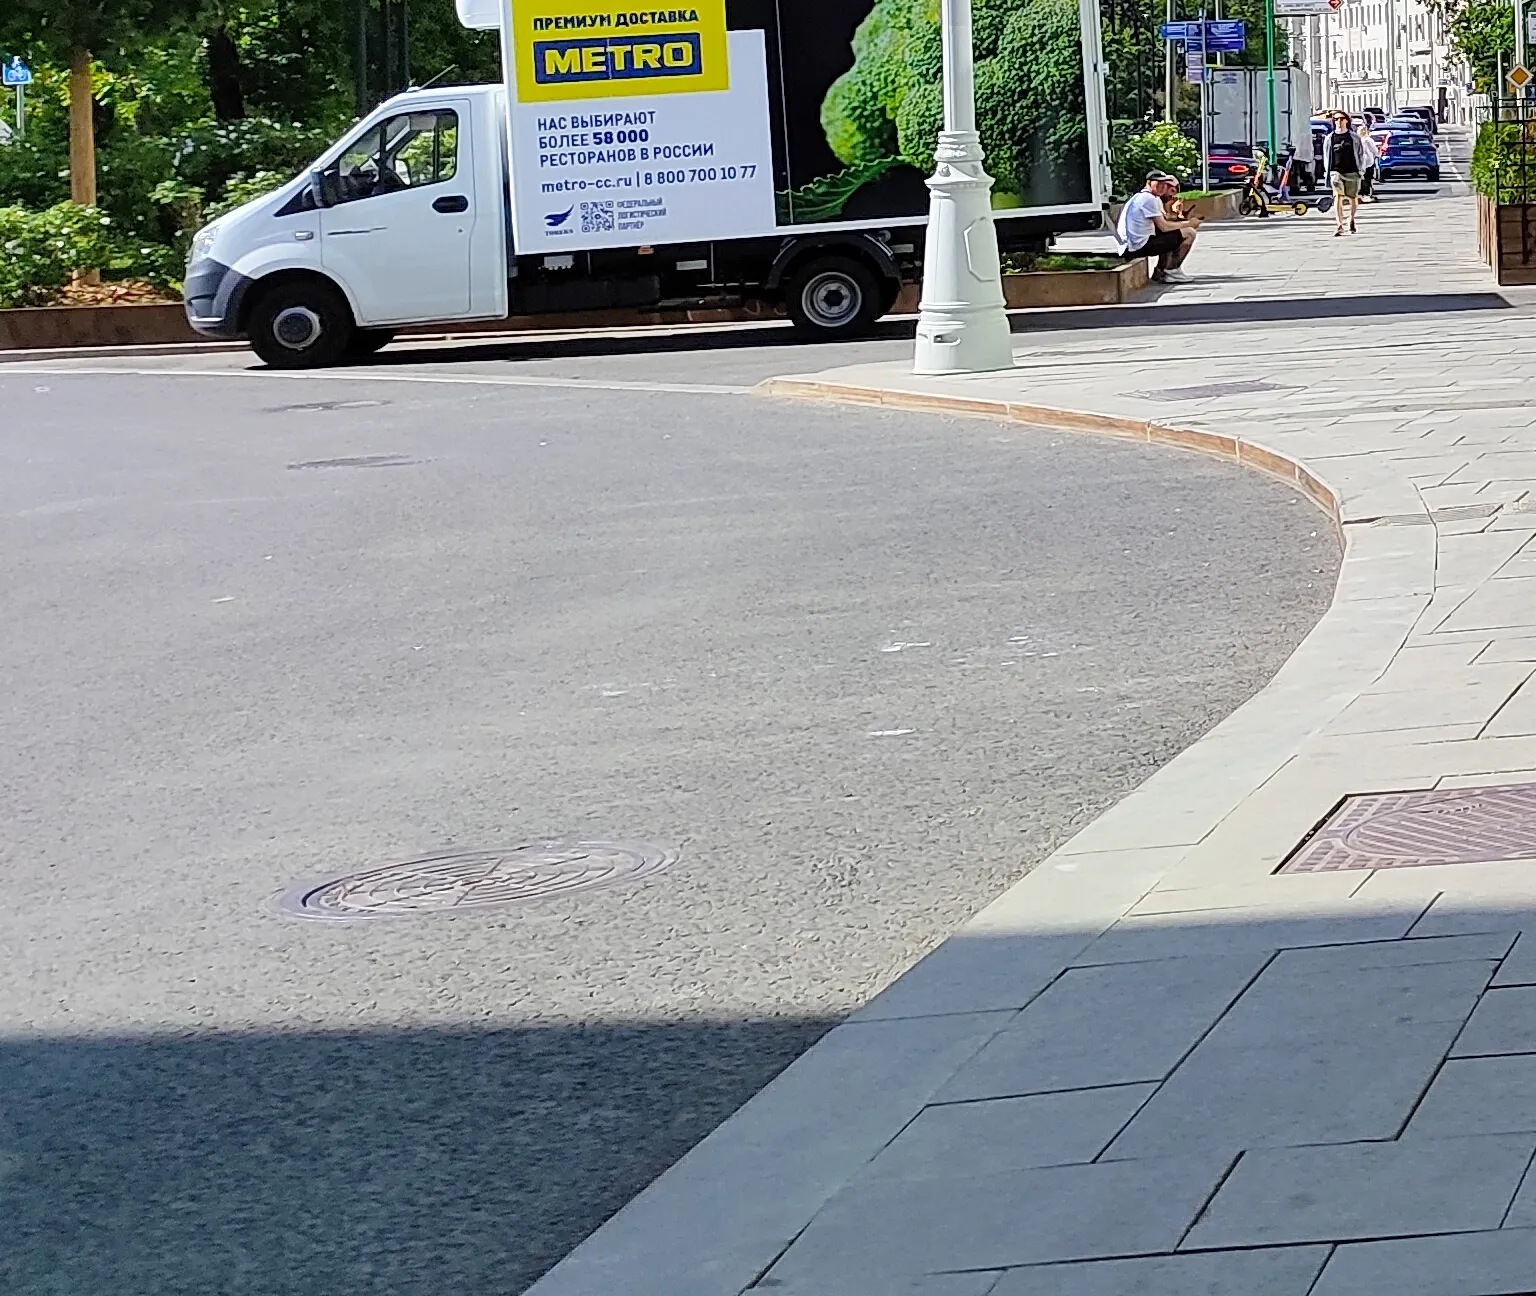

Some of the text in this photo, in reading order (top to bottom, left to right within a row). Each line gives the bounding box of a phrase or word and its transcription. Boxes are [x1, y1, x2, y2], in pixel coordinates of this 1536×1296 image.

[533, 9, 699, 31] ПРЕМИУМ ДОСТАВКА
[543, 41, 694, 75] METRO
[537, 110, 656, 132] НАС ВЫБИРАЮТ
[538, 129, 649, 149] БОЛЕЕ 58 000
[540, 143, 715, 168] РЕСТОРАНОВ В РОССИИ
[541, 164, 757, 194] metro-cc.ru 8 800 700 10 77
